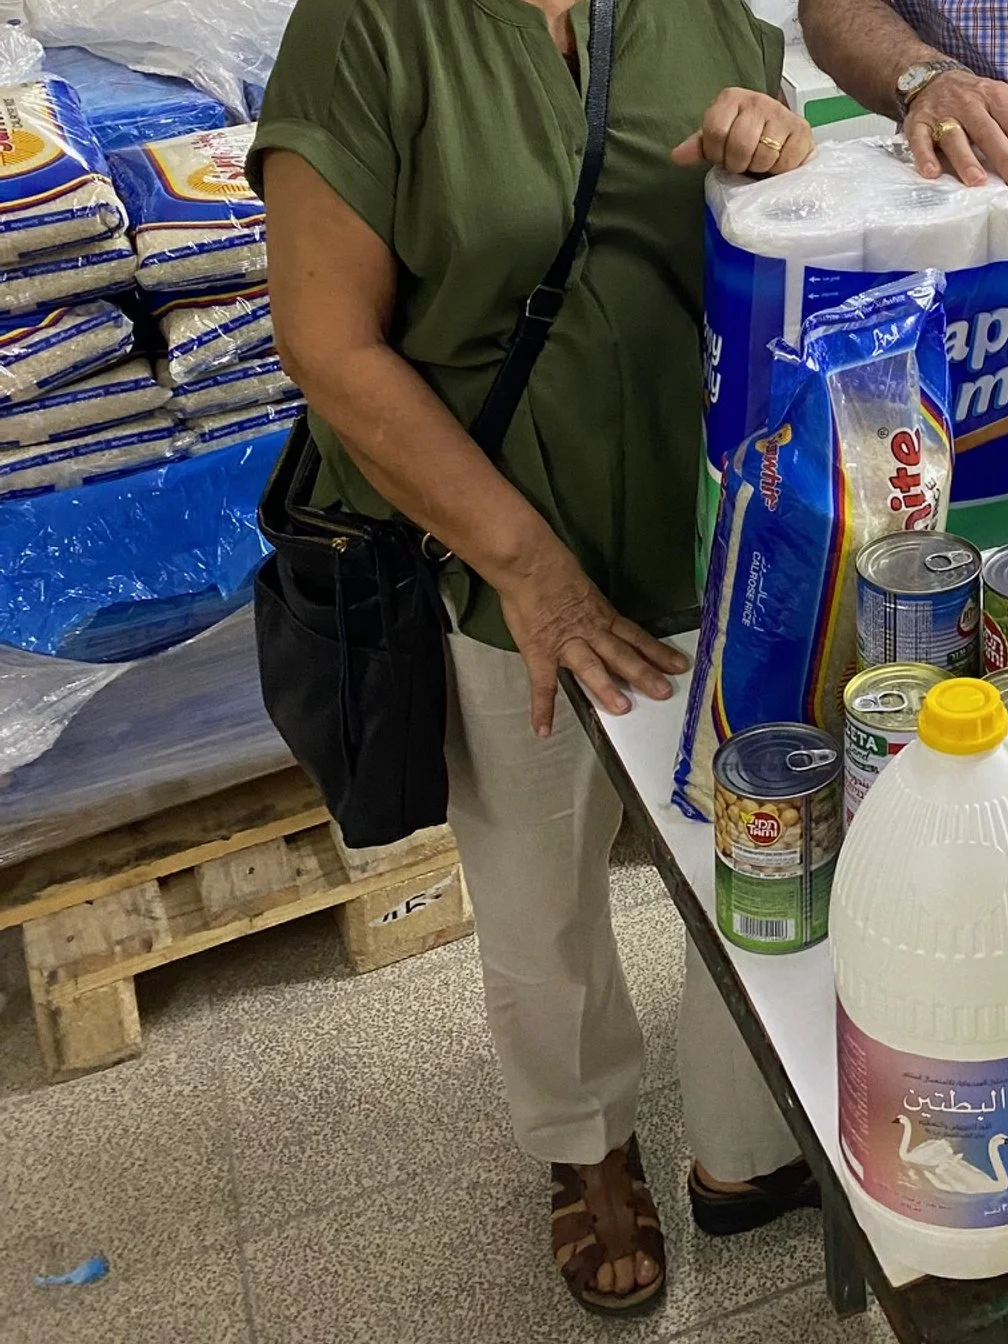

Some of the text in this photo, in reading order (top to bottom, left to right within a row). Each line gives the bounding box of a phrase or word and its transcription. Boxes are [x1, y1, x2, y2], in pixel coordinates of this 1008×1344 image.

[741, 551, 762, 628] CALROSE RICE
[903, 1086, 1007, 1121] البطتين
